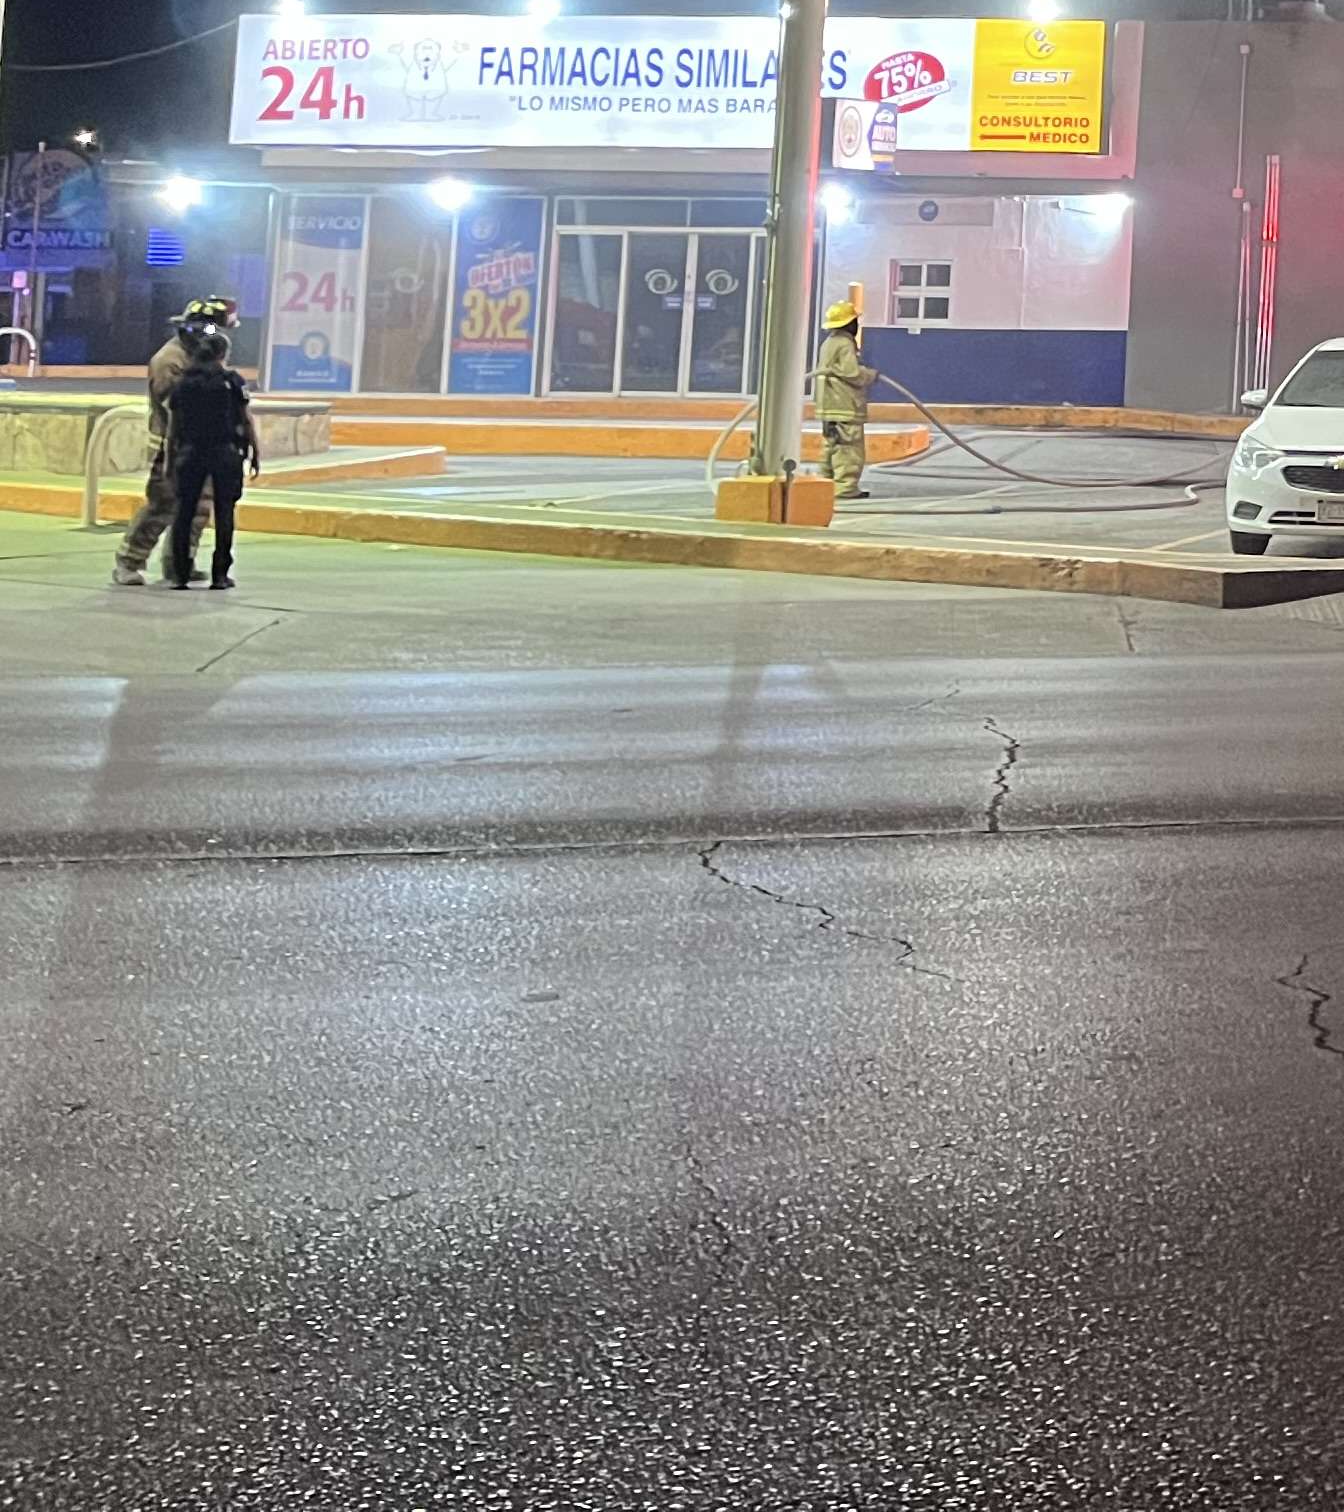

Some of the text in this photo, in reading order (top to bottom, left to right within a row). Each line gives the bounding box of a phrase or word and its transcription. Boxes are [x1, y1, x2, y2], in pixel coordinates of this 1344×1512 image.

[262, 37, 371, 61] ABIERTO
[478, 46, 848, 91] FARMACIAS SIMILAS
[873, 58, 932, 98] 75%
[1012, 70, 1072, 84] BEST
[256, 65, 366, 122] 24h
[550, 96, 613, 113] MISMO
[619, 97, 671, 114] PERO
[677, 97, 720, 115] MAS
[726, 98, 778, 115] BARA
[979, 115, 1090, 129] CONSULTORIO
[1029, 132, 1090, 144] MEDICO
[288, 215, 362, 232] SERVICIO
[279, 271, 356, 313] 24h
